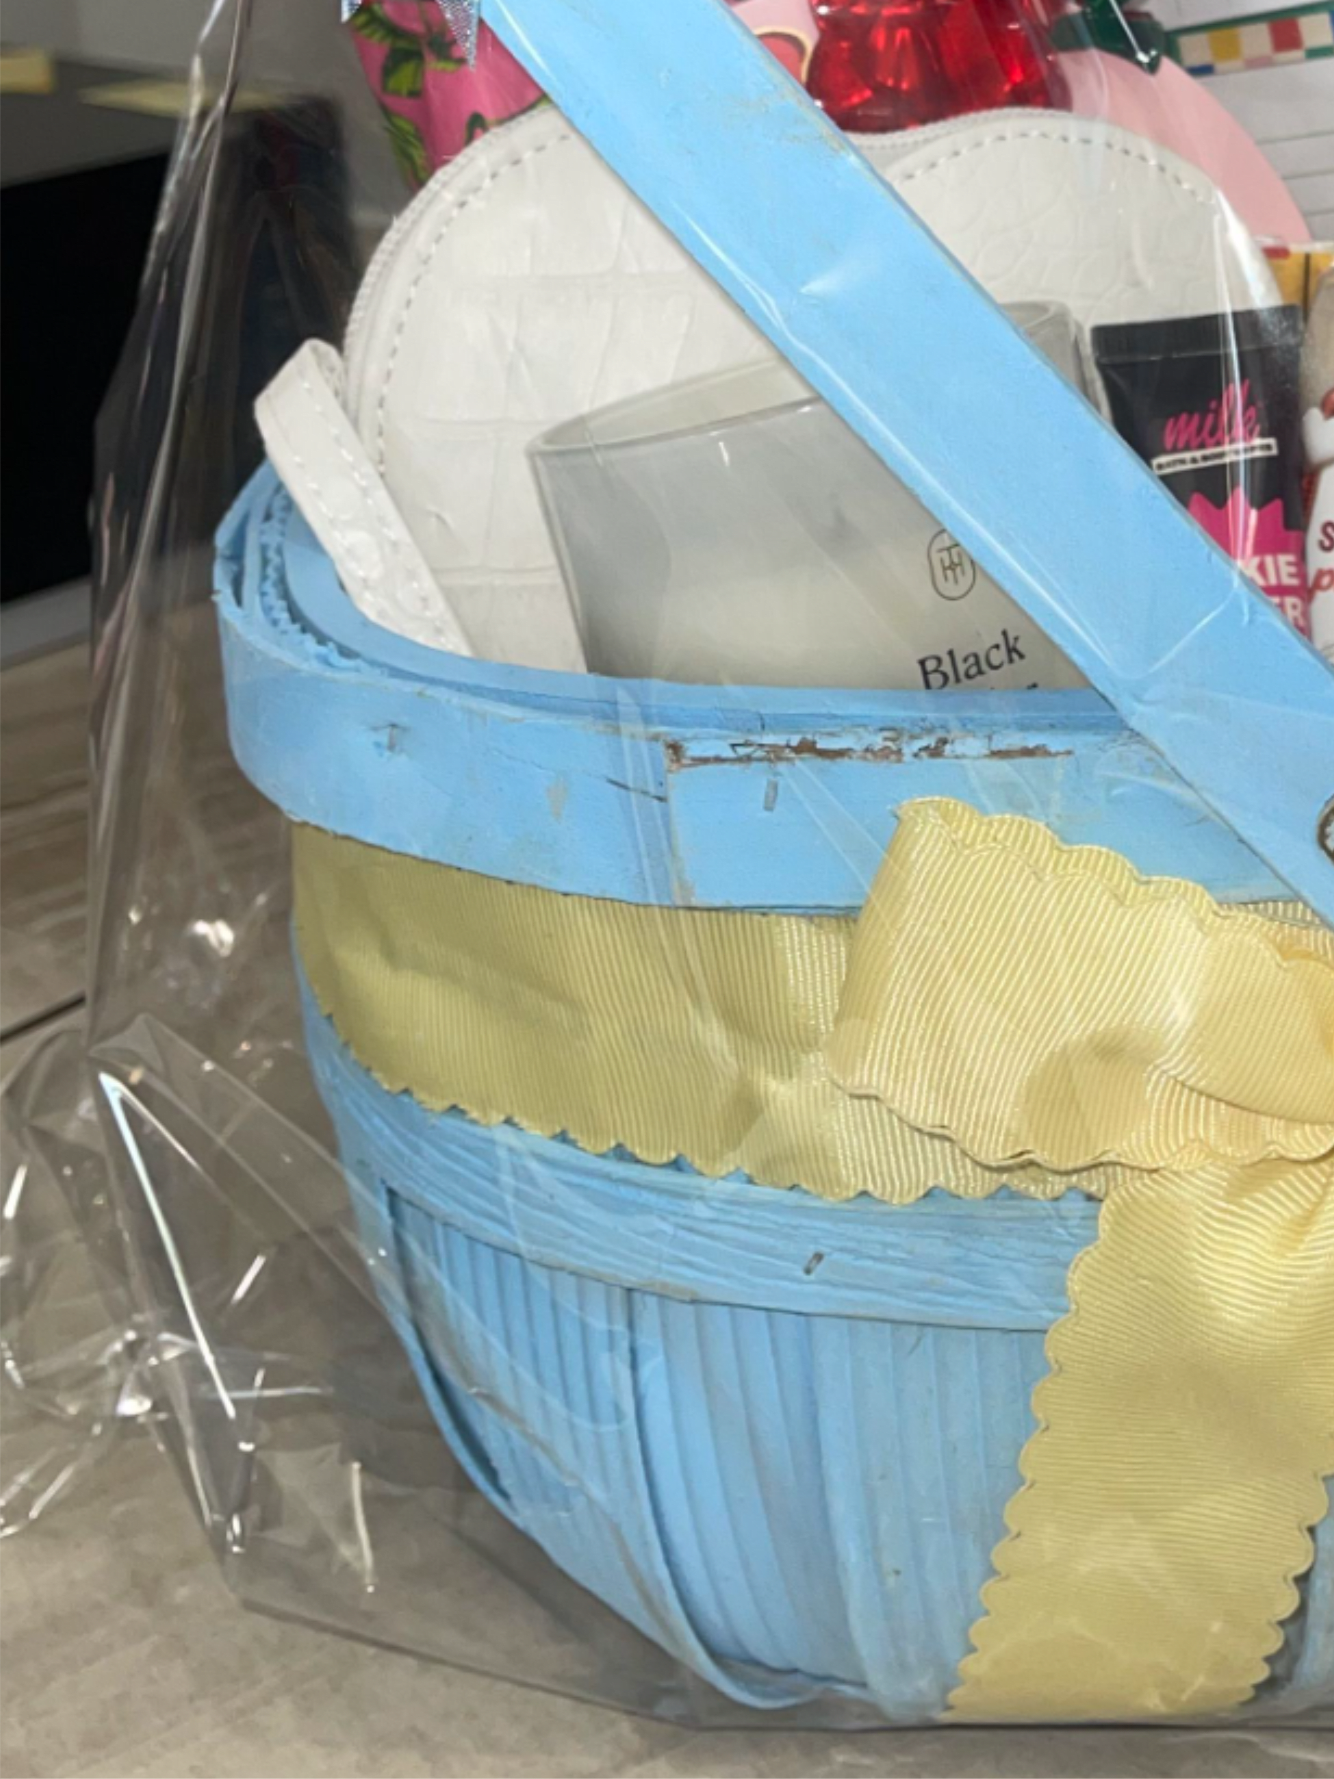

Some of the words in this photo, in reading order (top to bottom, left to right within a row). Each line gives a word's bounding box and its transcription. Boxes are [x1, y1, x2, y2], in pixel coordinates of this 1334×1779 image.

[1163, 378, 1261, 451] milk
[1238, 553, 1301, 587] KIE
[916, 628, 1026, 690] Black
